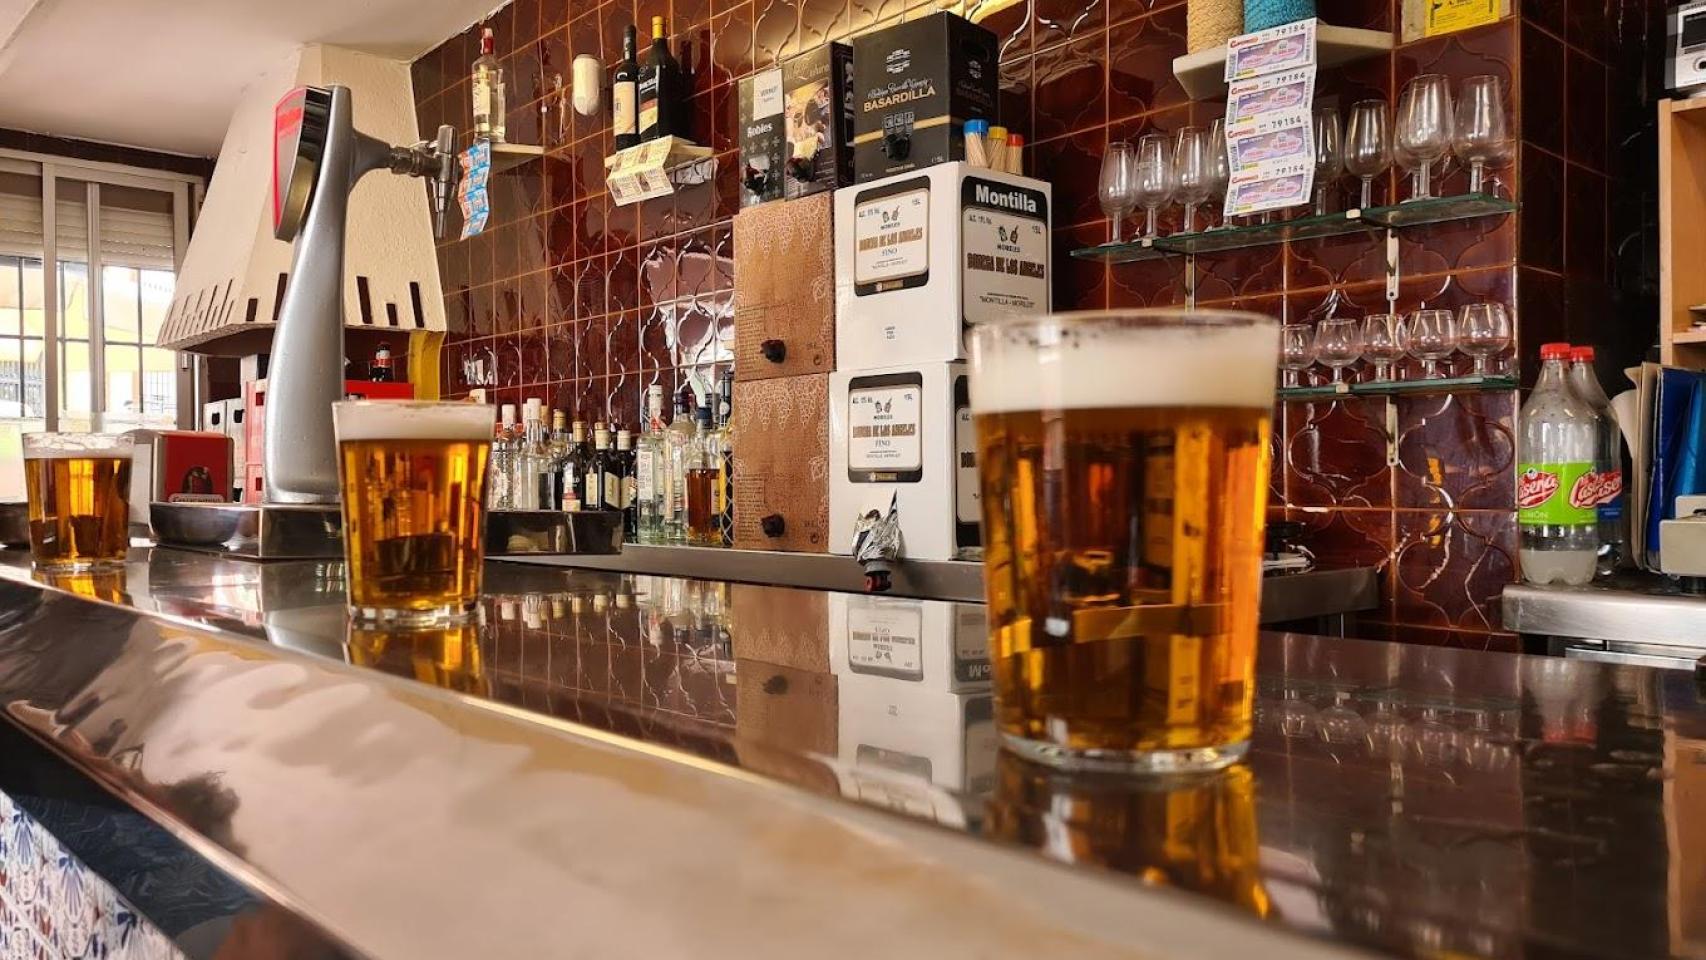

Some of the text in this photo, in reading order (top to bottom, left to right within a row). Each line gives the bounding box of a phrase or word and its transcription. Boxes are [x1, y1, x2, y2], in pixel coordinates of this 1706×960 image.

[863, 86, 936, 113] BASARDILLA
[747, 123, 773, 138] Robles
[975, 184, 1037, 213] Montilla
